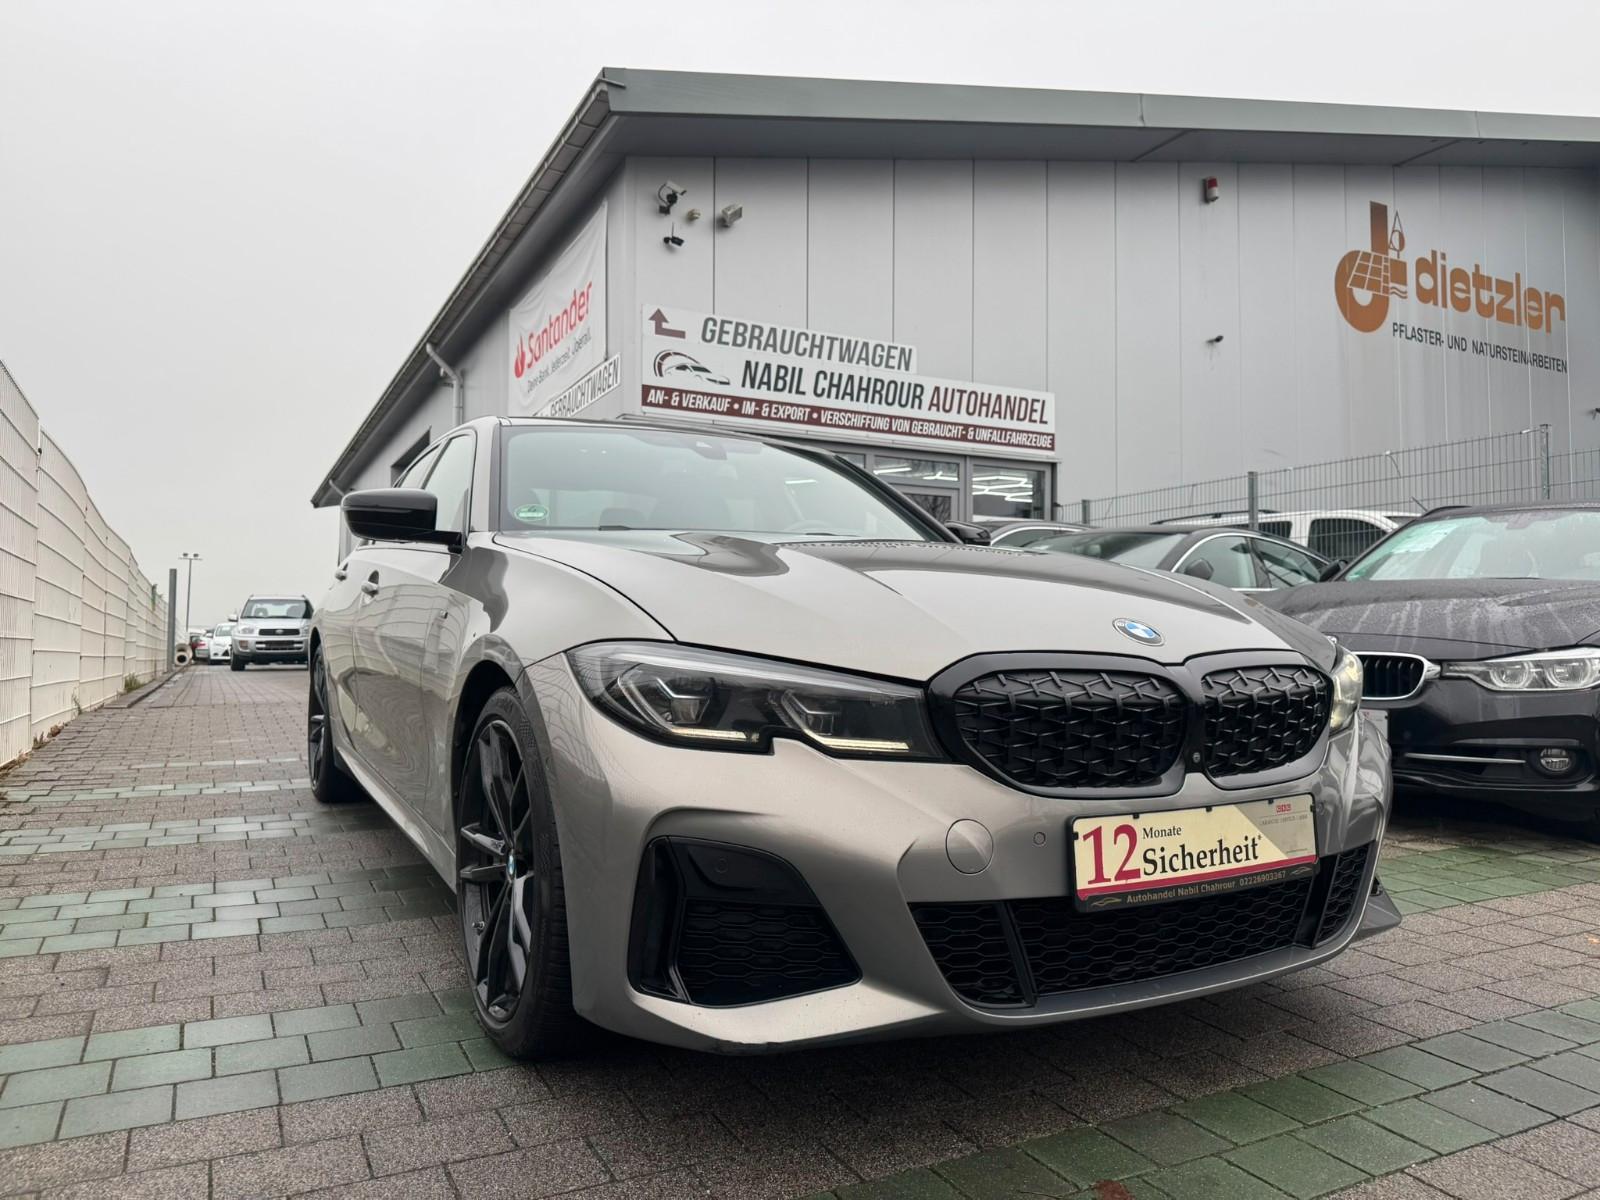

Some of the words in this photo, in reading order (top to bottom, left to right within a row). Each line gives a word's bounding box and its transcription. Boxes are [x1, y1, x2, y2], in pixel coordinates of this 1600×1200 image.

[1415, 249, 1566, 336] dietzler
[527, 281, 592, 369] Santander
[701, 317, 912, 371] GEBRAUCHTWAGEN
[1392, 322, 1444, 346] PFLASTER-
[1447, 336, 1467, 352] UND
[1472, 340, 1567, 374] NATURSTEINARBEITEN
[648, 389, 668, 404] AN-
[671, 392, 679, 406] &
[682, 393, 730, 412] VERKAUF
[741, 404, 759, 416] IM-
[761, 406, 769, 417] &
[771, 407, 810, 422] EXPORT
[820, 410, 889, 431] VERSCHIFFUNG
[892, 419, 909, 433] VON
[912, 421, 966, 440] GEBRAUCHT-
[968, 427, 974, 440] &
[975, 428, 1053, 448] UNFALLFAHRZEUGE
[741, 360, 806, 396] NABIL
[813, 370, 924, 410] CHAHROUR
[928, 385, 1048, 425] AUTOHANDEL
[1083, 823, 1141, 885] 12
[1143, 825, 1182, 839] Monate
[1127, 887, 1175, 903] Autohandel
[1177, 884, 1199, 897] Nabil
[1201, 881, 1235, 893] Chahrour
